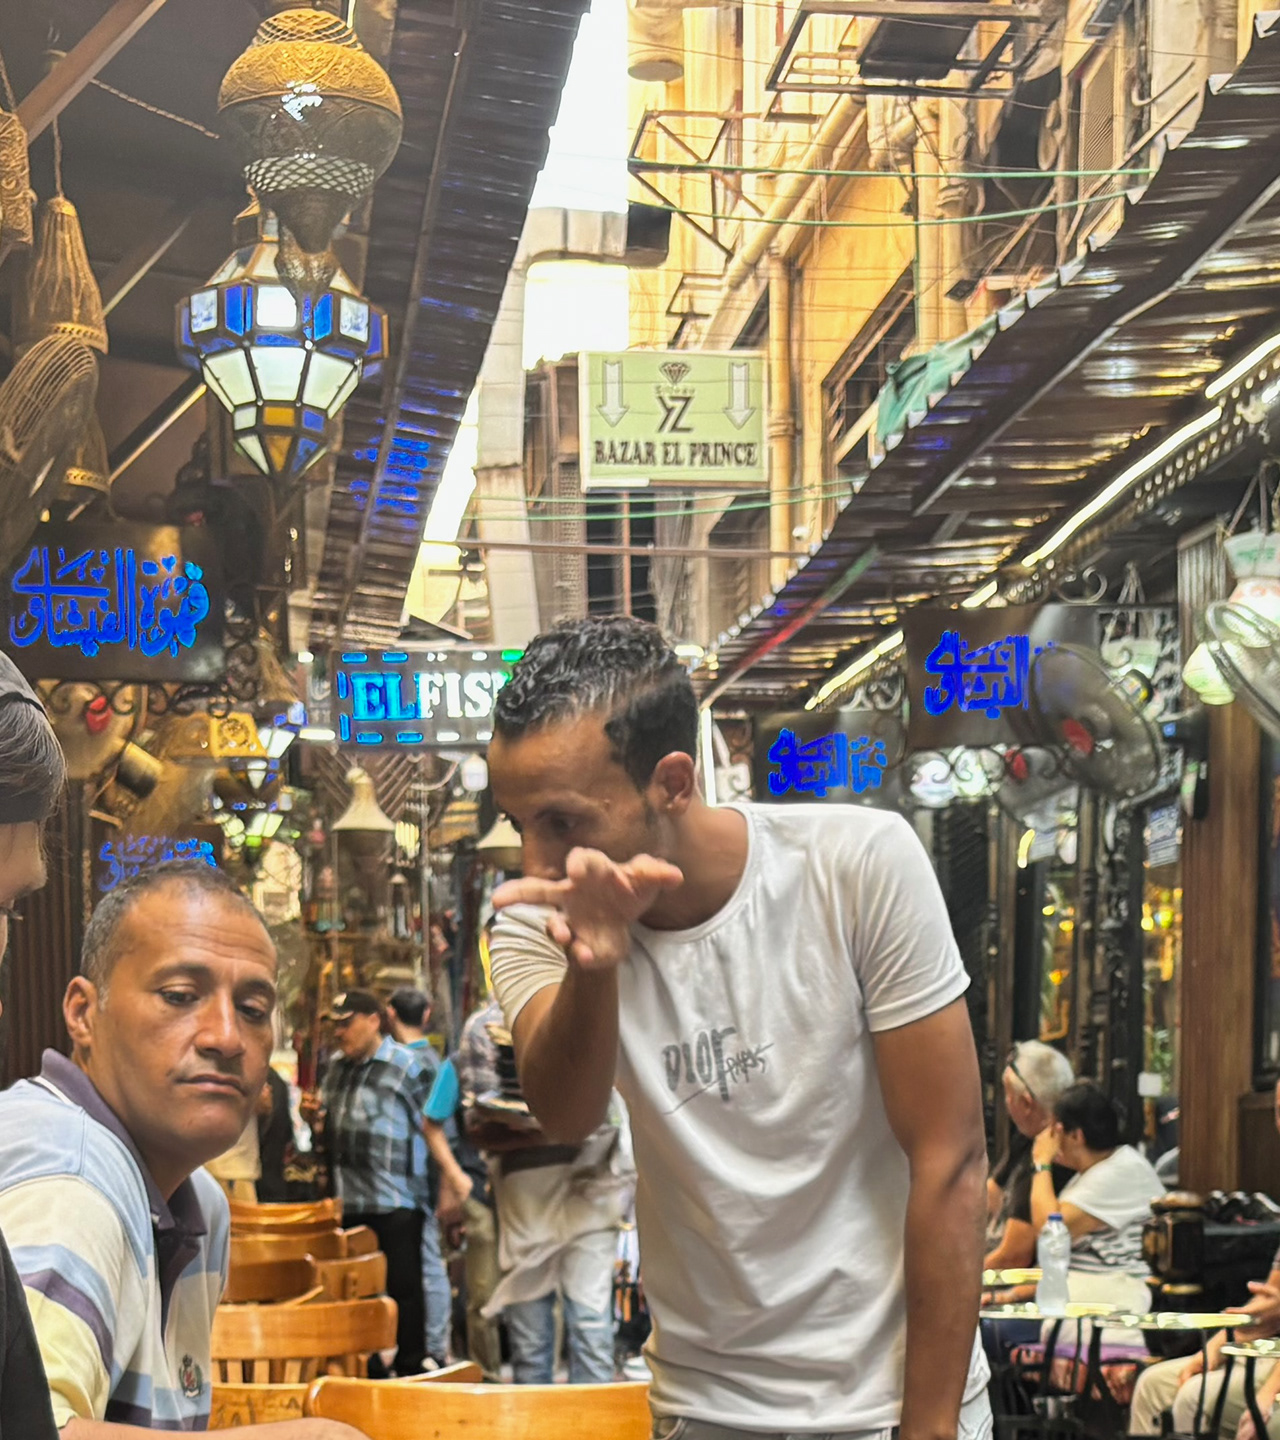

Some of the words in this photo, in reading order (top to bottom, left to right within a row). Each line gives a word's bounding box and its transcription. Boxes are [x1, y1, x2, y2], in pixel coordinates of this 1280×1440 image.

[594, 439, 657, 466] BAZAR
[661, 441, 685, 467] EL
[689, 441, 759, 468] PRINCE
[350, 672, 417, 722] EL
